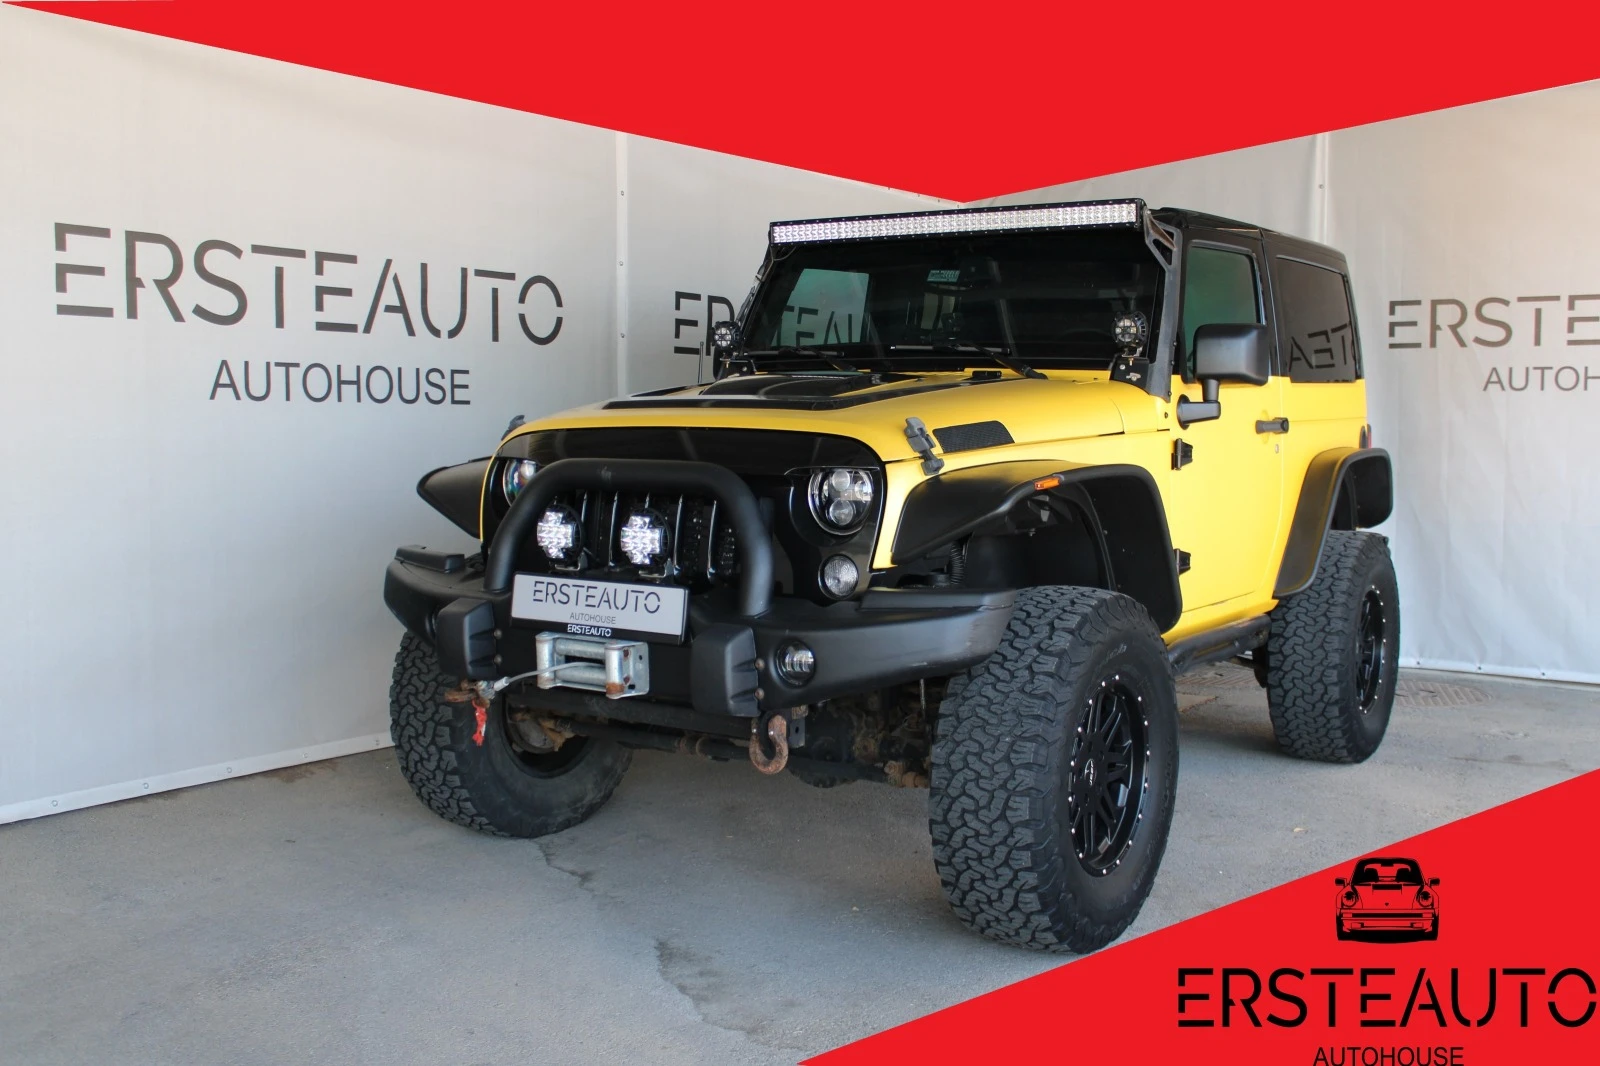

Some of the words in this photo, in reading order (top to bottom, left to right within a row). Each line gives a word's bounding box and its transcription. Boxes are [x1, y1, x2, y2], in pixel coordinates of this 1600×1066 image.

[55, 222, 563, 346] ERSTEAUTO
[1388, 294, 1600, 349] ERSTE
[210, 359, 471, 405] AUTOHOUSE
[532, 580, 661, 614] ERSTEAUTO
[567, 623, 612, 637] ERSTEAUTO
[569, 612, 617, 625] AUTOHOUSE
